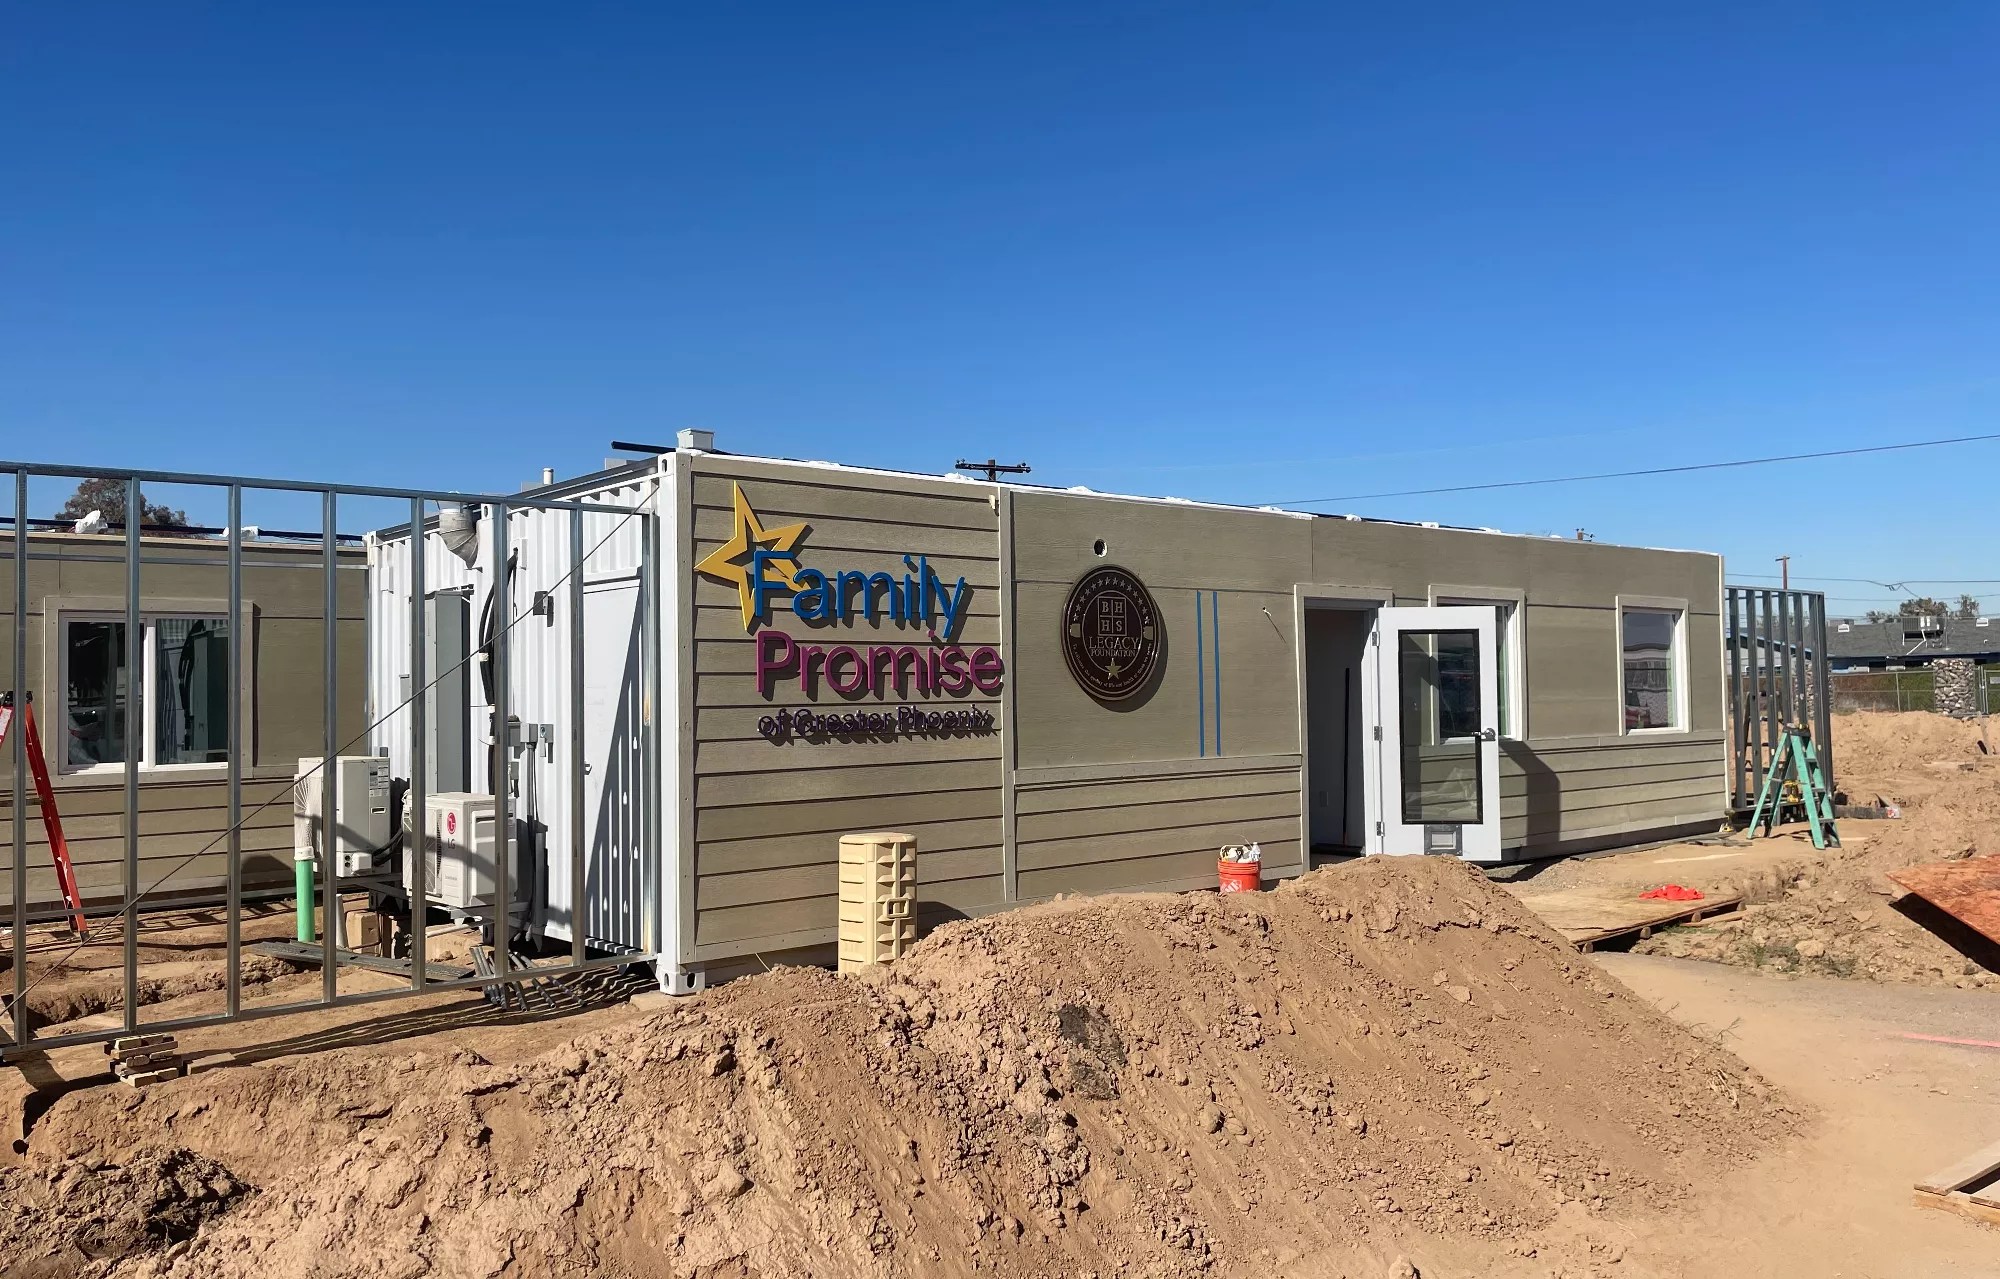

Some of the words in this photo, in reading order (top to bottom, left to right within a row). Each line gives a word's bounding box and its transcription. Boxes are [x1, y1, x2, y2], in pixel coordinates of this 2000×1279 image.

[754, 550, 966, 638] Family
[1089, 636, 1139, 650] LEGACY
[1091, 649, 1136, 657] FOUNDATION
[756, 630, 1003, 692] Promise
[757, 708, 787, 737] of
[794, 708, 892, 737] Greater
[896, 704, 990, 732] Phoenix
[447, 837, 456, 850] LG
